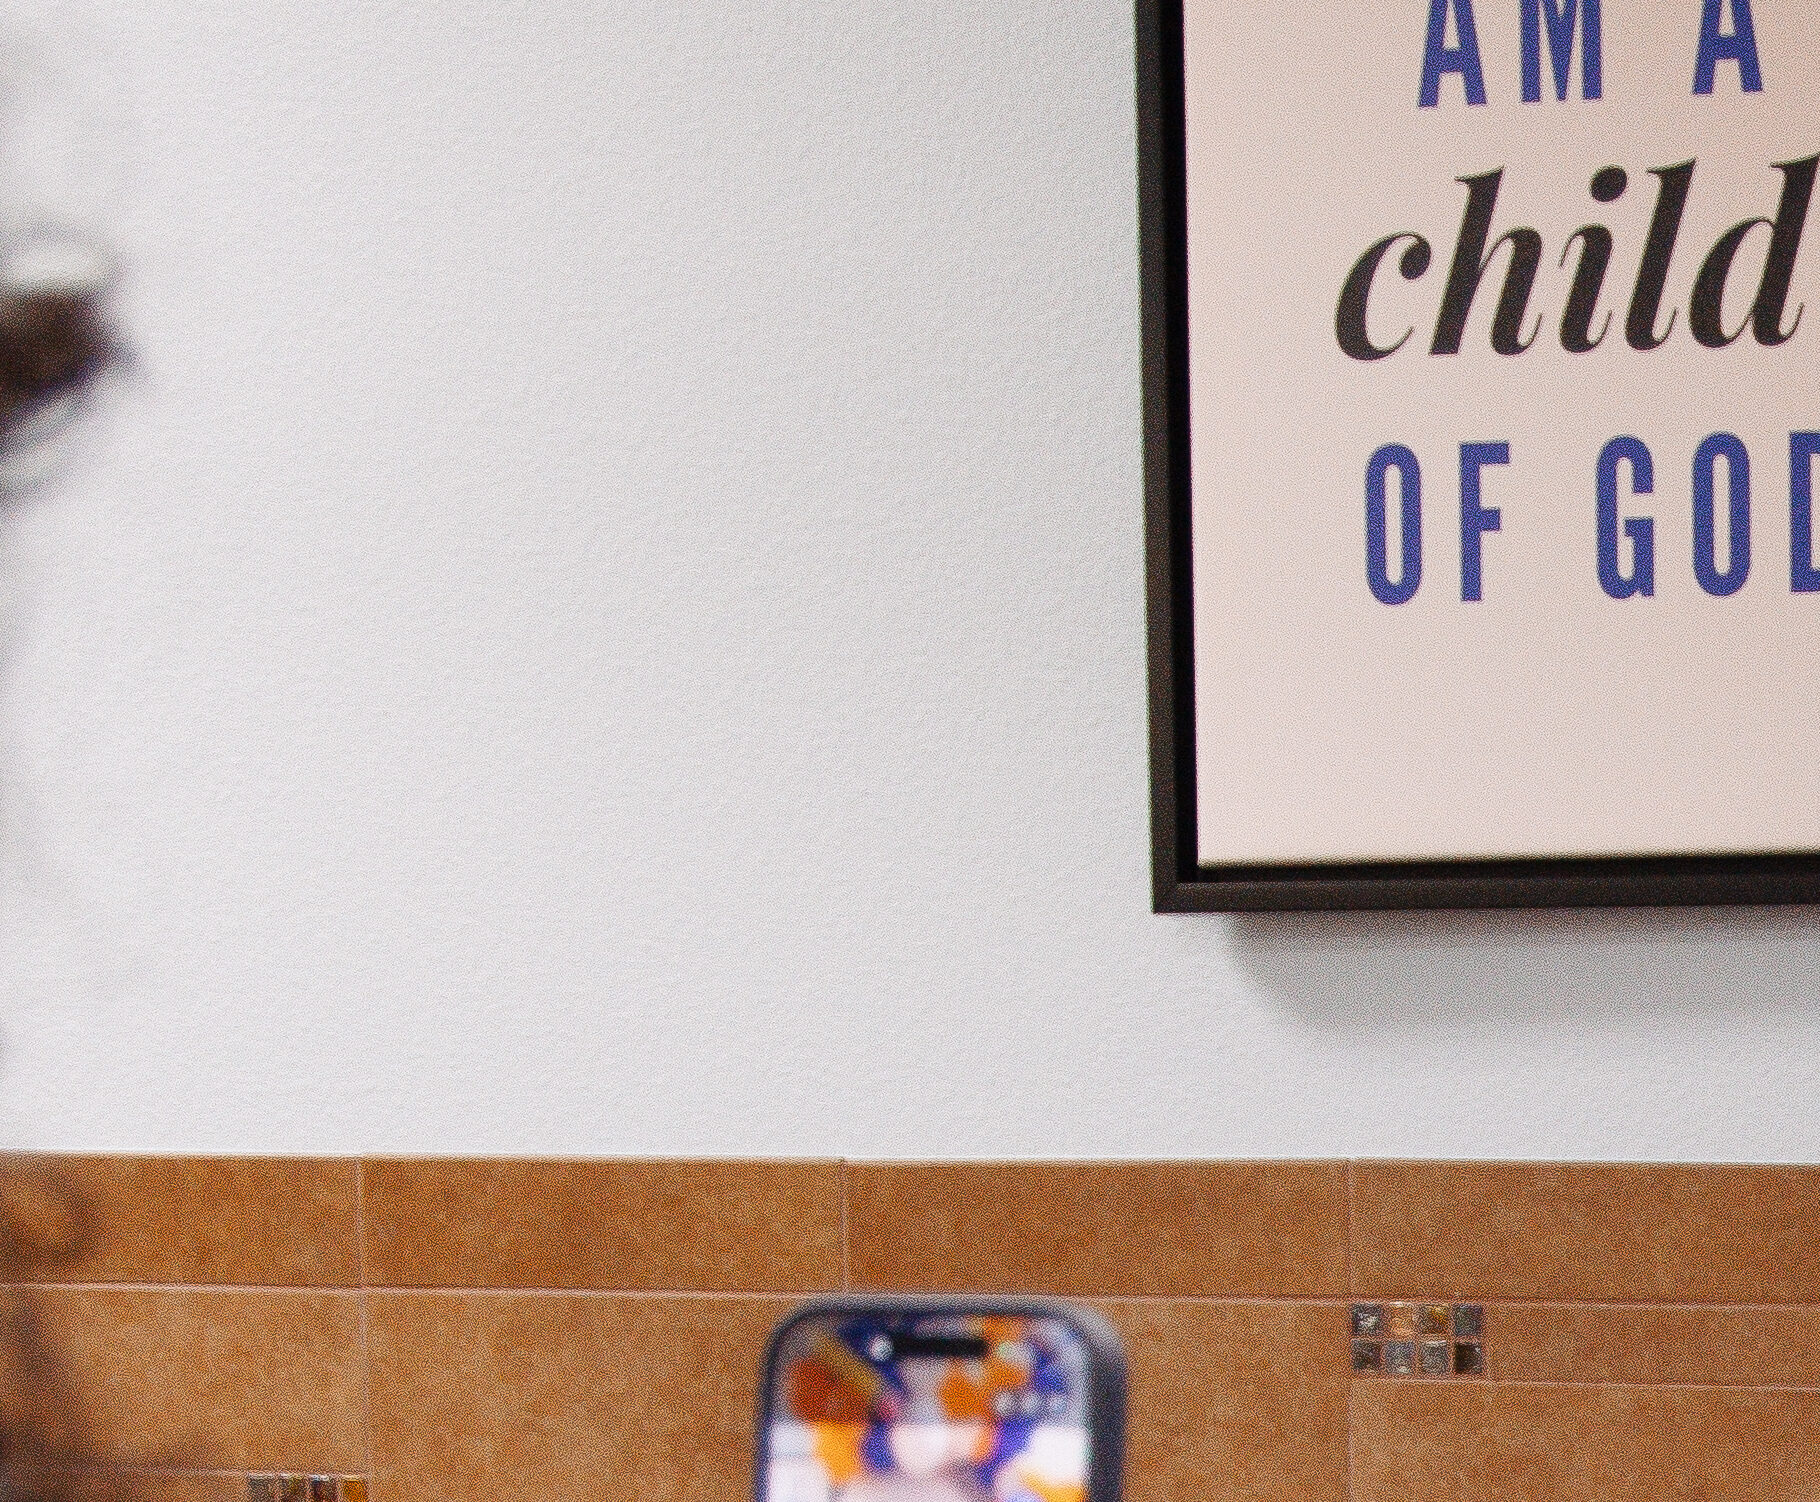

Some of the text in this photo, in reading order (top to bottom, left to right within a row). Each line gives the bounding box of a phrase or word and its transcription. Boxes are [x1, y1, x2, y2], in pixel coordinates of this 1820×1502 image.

[1417, 0, 1765, 107] AM A
[1333, 151, 1820, 361] child
[1365, 441, 1511, 605] OF
